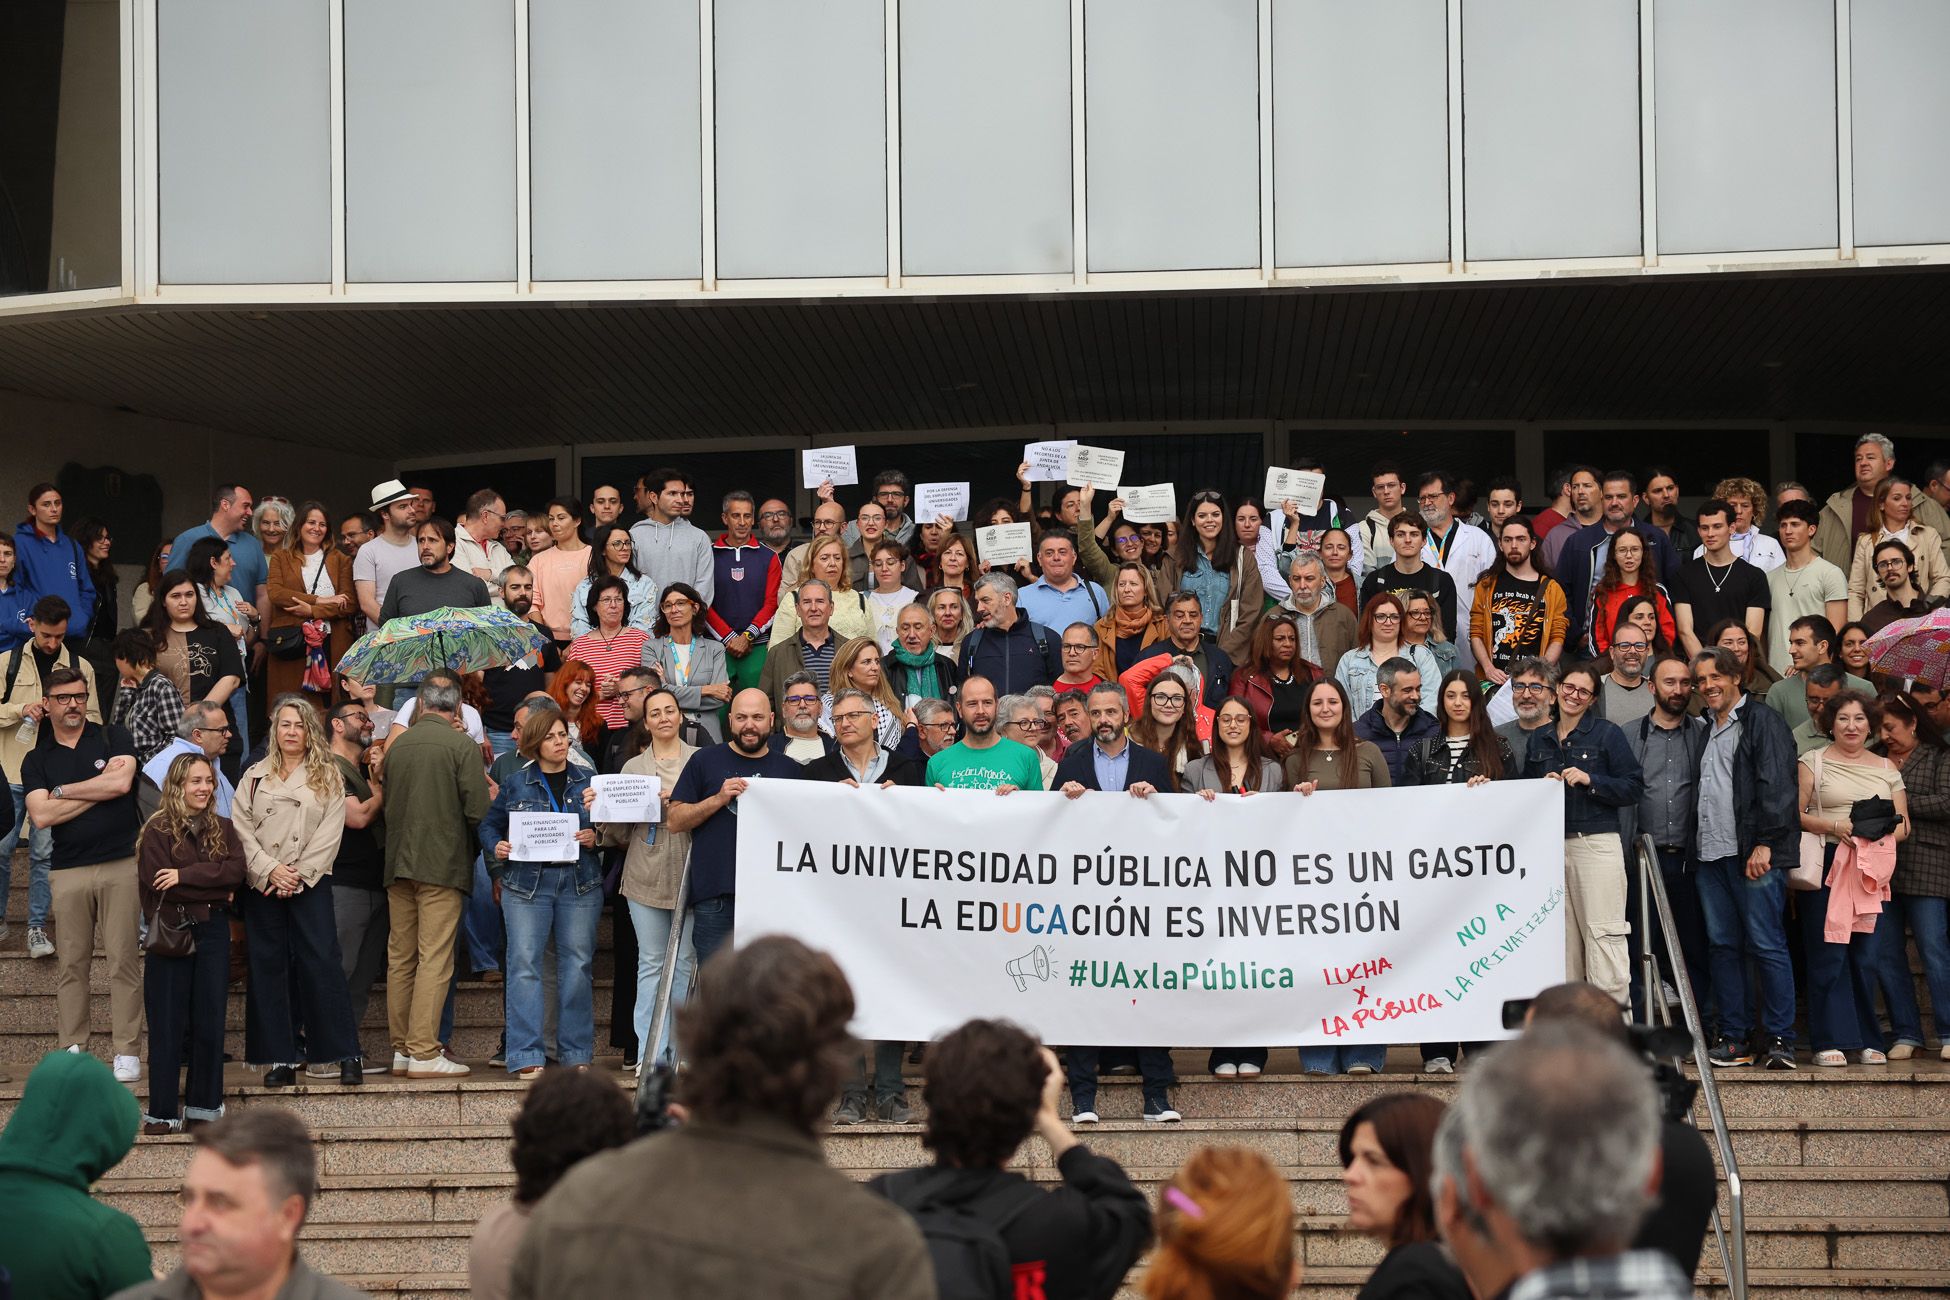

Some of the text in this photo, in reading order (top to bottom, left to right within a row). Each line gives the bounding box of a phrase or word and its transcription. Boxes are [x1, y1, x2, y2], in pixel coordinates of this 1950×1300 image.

[776, 841, 1526, 888] LA UNIVERSIDAD PÚBLICA NO ES UN GASTO,
[901, 892, 1400, 938] LA EDUCACIÓN ES INVERSIÓN
[1456, 902, 1516, 947] NO A
[1068, 958, 1294, 990] #UAxlaPública
[1322, 956, 1393, 986] LUCHA
[1445, 975, 1474, 1002] LA
[1321, 993, 1443, 1037] LA PÚBLICA
